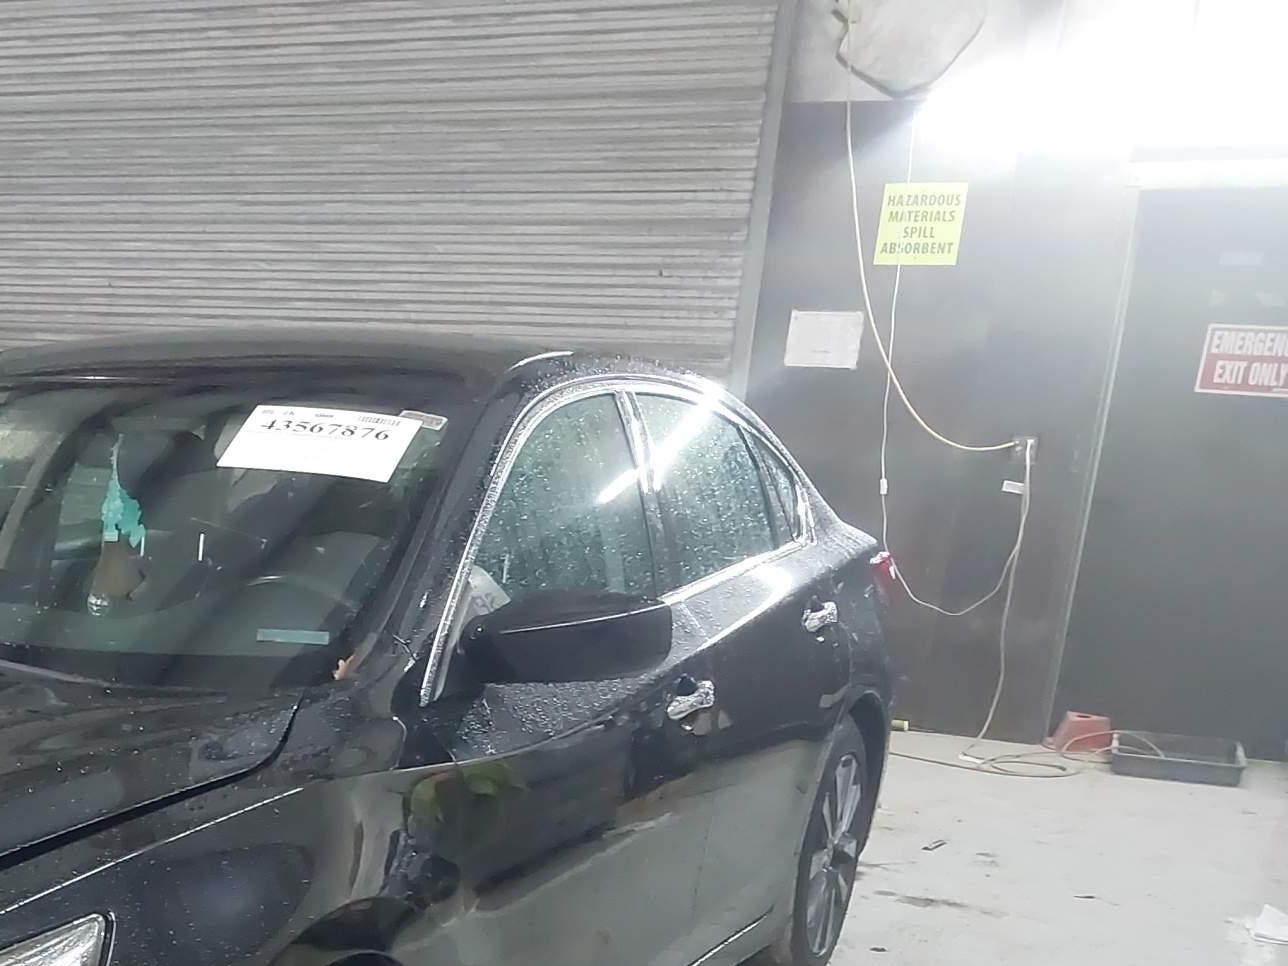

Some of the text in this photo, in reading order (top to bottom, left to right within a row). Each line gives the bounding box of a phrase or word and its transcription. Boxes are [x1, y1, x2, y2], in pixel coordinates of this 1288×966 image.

[887, 194, 962, 207] HAZARDOUS
[887, 210, 956, 223] MATERIALS
[903, 226, 935, 239] SPILL
[1213, 360, 1288, 387] EXIT ONLY
[260, 418, 391, 441] 43567876
